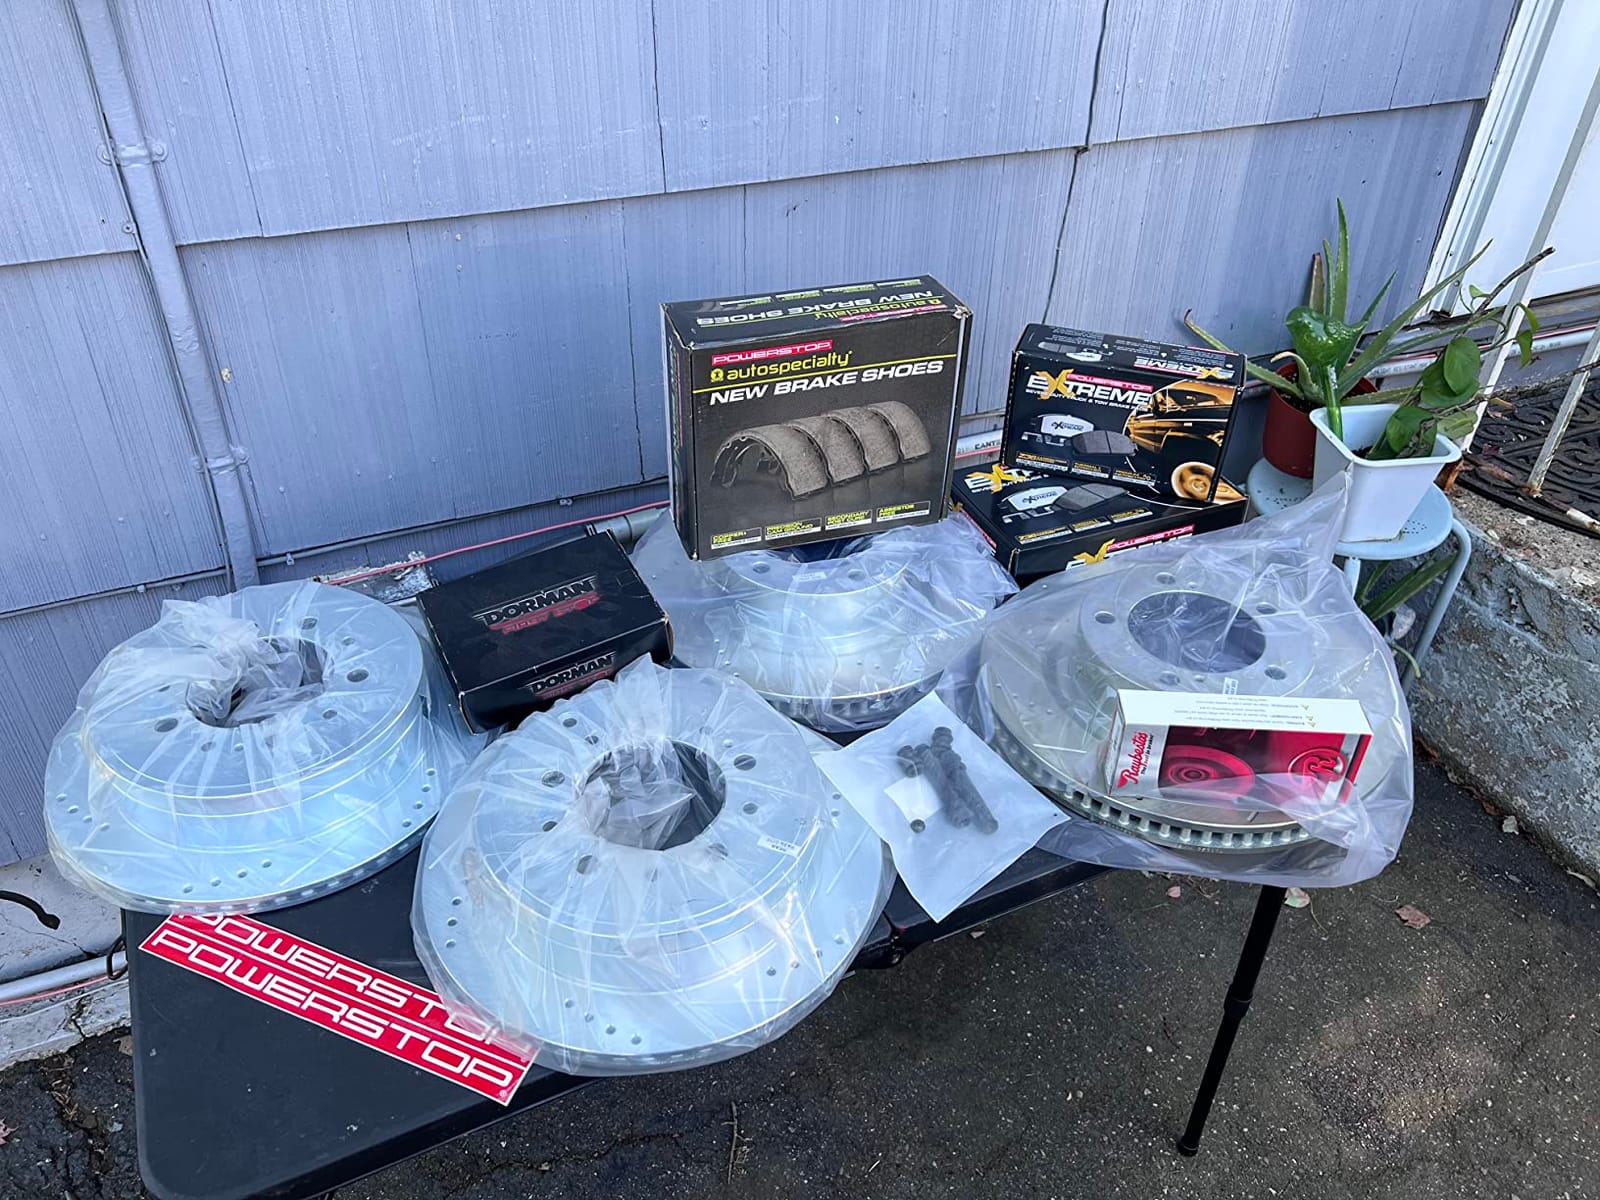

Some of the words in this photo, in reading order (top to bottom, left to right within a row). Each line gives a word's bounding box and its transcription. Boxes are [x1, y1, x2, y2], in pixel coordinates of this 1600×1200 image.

[787, 297, 873, 315] BRAKE
[878, 290, 933, 303] NEW
[696, 309, 784, 326] SHOES
[712, 341, 831, 365] POWERSTOP
[727, 351, 852, 382] autospecialty
[708, 384, 770, 406] NEW
[773, 371, 857, 397] BRAKE
[860, 360, 944, 384] SHOES
[1027, 369, 1152, 407] EXTREME
[482, 578, 596, 627] DORMAN
[529, 652, 616, 693] DORMAN
[1118, 731, 1149, 787] Raybestos
[151, 929, 514, 1088] POWERSTOP
